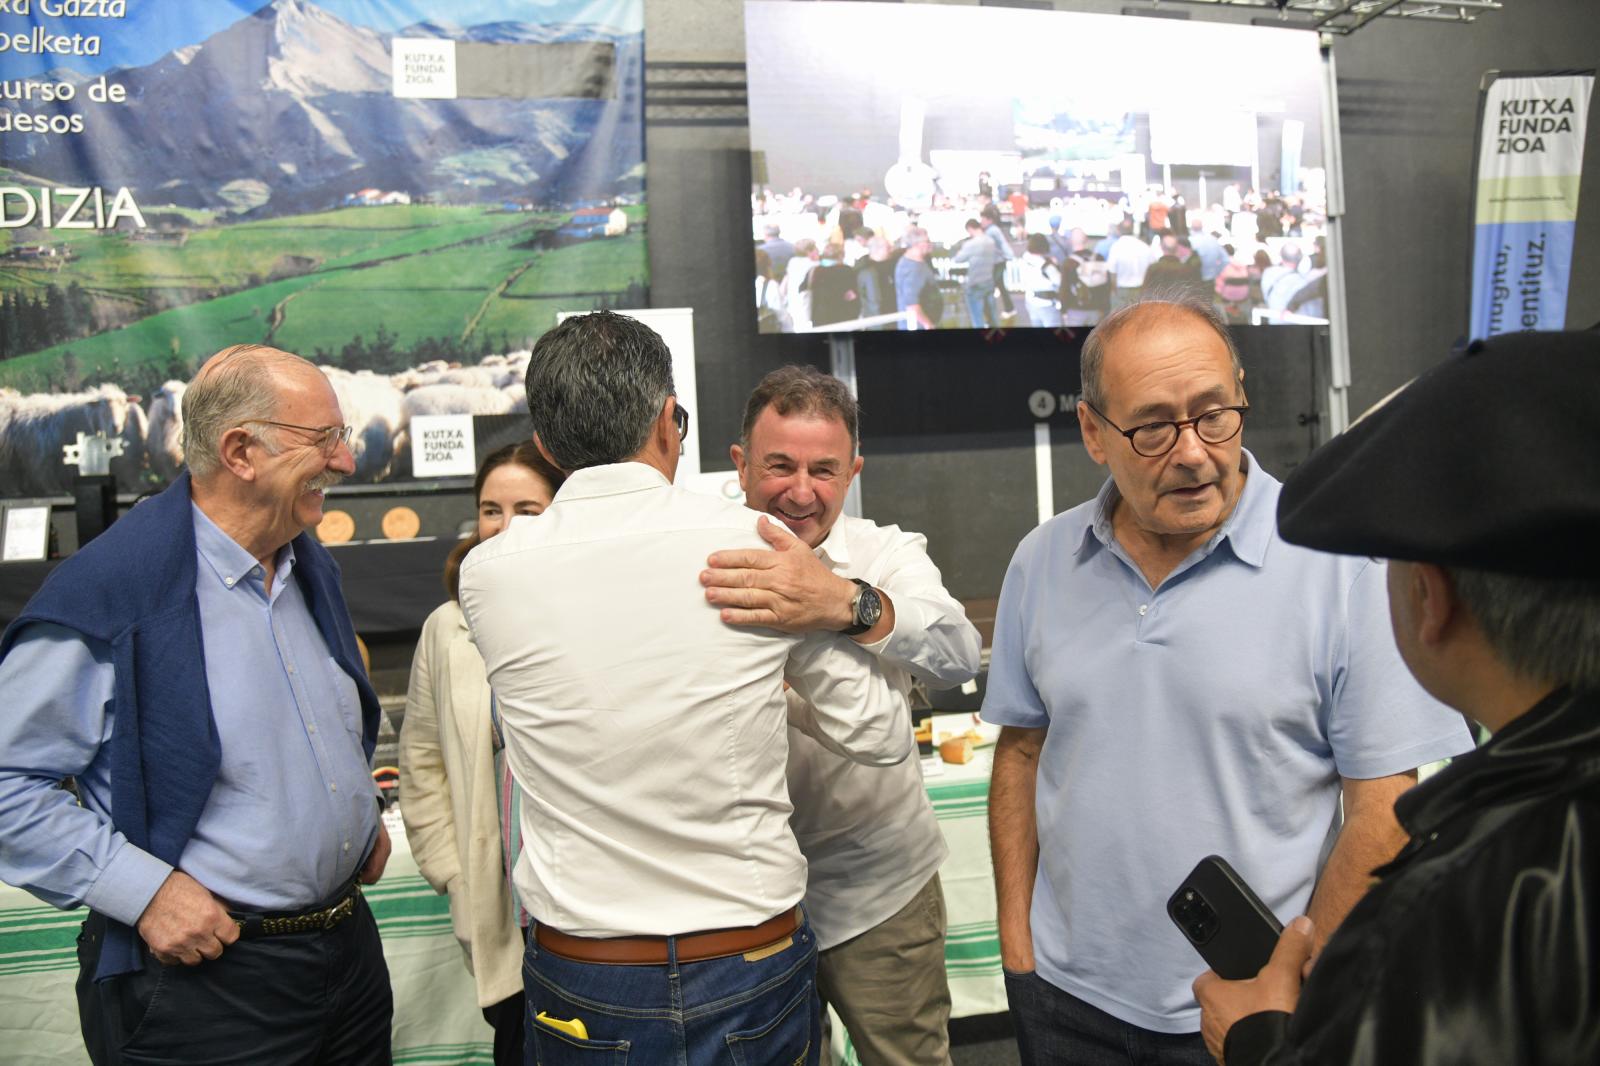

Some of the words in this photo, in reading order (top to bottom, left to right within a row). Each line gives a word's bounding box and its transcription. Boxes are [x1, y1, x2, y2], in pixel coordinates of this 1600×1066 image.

[40, 0, 126, 18] Gazta
[404, 53, 446, 63] KUTXA
[404, 63, 446, 73] FUNDA
[404, 74, 434, 84] ZIOA
[0, 80, 75, 101] urso
[88, 76, 126, 103] de
[1500, 97, 1575, 117] KUTXA
[1499, 117, 1572, 135] FUNDA
[1497, 136, 1546, 155] ZIOA
[0, 186, 147, 229] DIZIA
[423, 429, 464, 440] KUTXA
[424, 440, 464, 450] FUNDA
[425, 451, 453, 461] ZIOA
